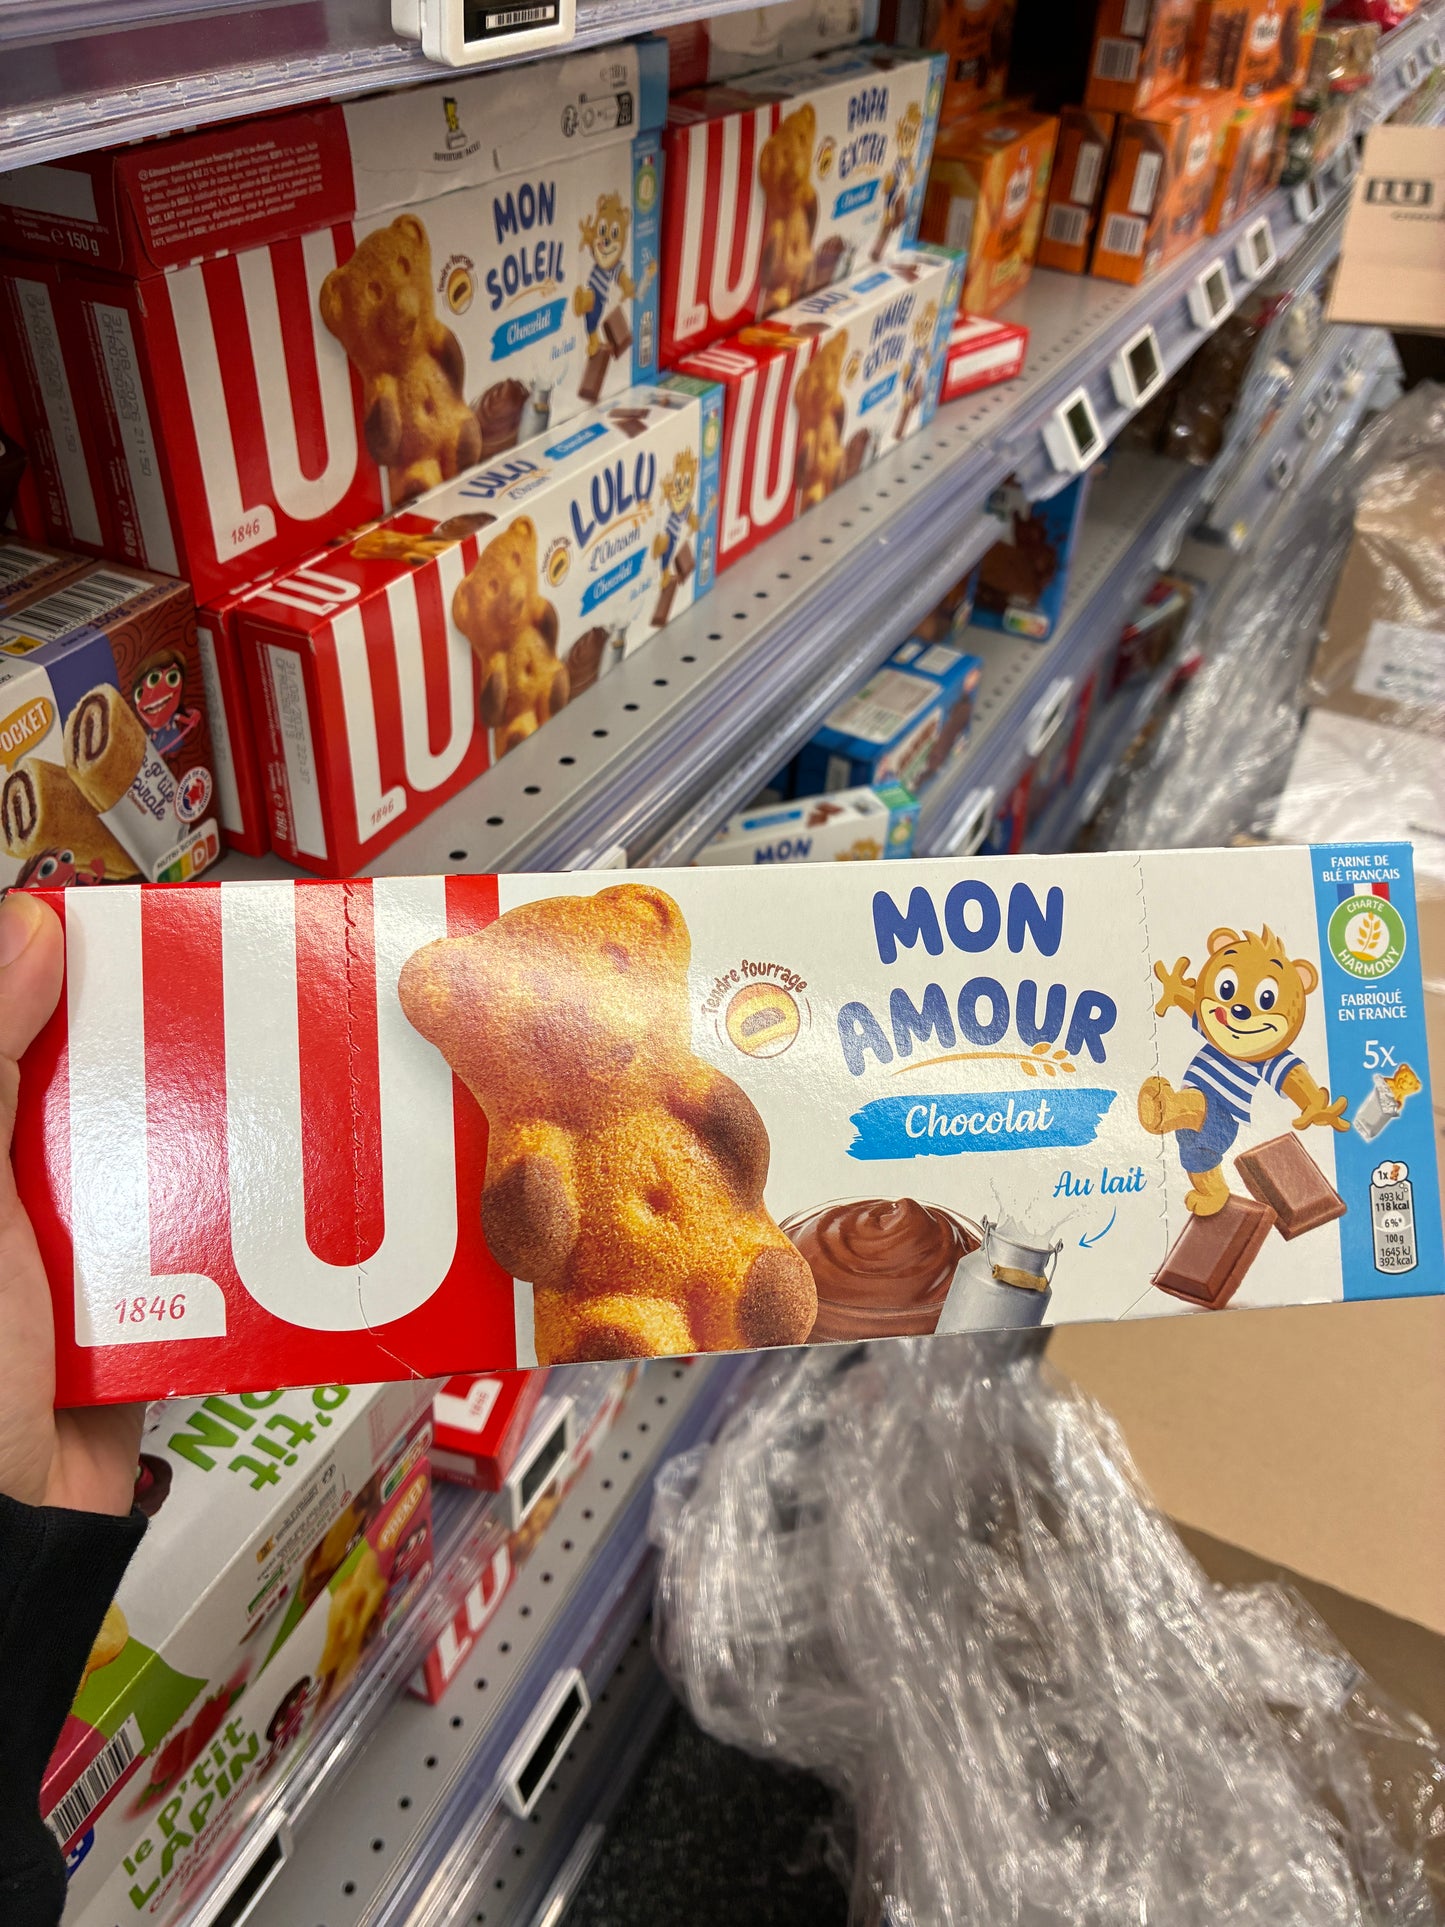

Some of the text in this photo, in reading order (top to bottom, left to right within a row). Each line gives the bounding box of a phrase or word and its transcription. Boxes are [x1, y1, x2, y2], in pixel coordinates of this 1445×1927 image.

[493, 181, 556, 245] MON
[674, 104, 771, 343] LU
[486, 241, 565, 311] SOLEIL
[163, 220, 358, 564] LU
[720, 339, 811, 554] LU
[459, 461, 538, 499] LULU
[570, 451, 657, 550] LULU
[230, 517, 261, 546] 1846
[331, 540, 474, 844] LU
[0, 701, 48, 753] OCKET
[371, 799, 395, 826] 1846
[755, 838, 813, 865] MON
[1331, 854, 1389, 868] FARINE DE
[1322, 867, 1401, 883] BLÉ FRANÇAIS
[872, 879, 1065, 966] MON
[1347, 899, 1385, 914] CHARTE
[1338, 945, 1400, 976] HARMONY
[701, 959, 808, 1015] Tendre fourrage
[1341, 988, 1403, 1007] FABRIQUÉ
[836, 976, 1118, 1078] AMOUR
[1338, 1005, 1408, 1022] EN FRANCE
[1362, 1039, 1398, 1070] 5x
[64, 877, 459, 1348] LU
[905, 1098, 1055, 1140] Chocolat
[1052, 1166, 1148, 1200] Au lait
[1378, 1170, 1389, 1181] 1x
[1375, 1200, 1411, 1212] 118 kcal
[1379, 1191, 1405, 1202] 493 kJ
[1381, 1247, 1401, 1257] 1645
[1386, 1234, 1405, 1245] 100 g
[1380, 1255, 1414, 1267] 392 kcal
[114, 1291, 187, 1326] 1846
[122, 1838, 155, 1877] le
[157, 1717, 246, 1838] P'tit
[128, 1730, 260, 1911] LAPIN
